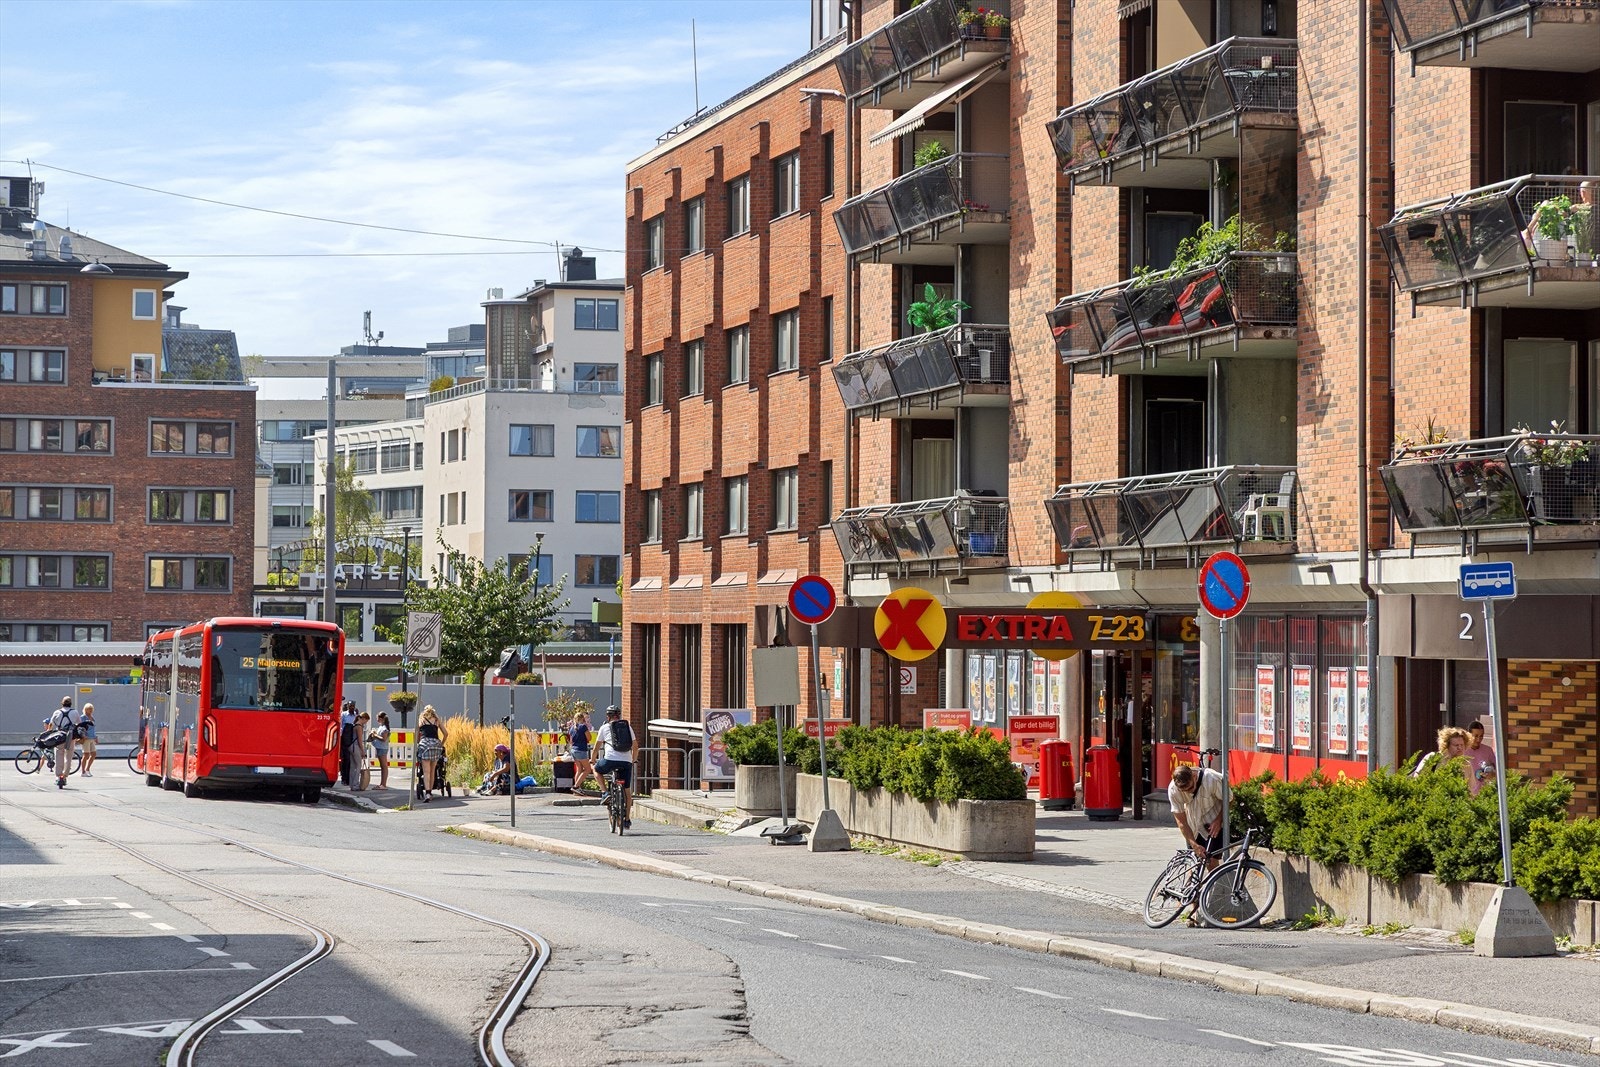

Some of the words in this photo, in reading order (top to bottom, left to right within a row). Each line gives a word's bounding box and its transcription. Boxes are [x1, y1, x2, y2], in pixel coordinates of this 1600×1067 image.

[335, 536, 412, 558] ESTAURAN
[314, 564, 421, 581] LARSEN
[413, 613, 434, 623] Son
[878, 598, 936, 650] X
[957, 614, 1074, 642] EXTRA
[1087, 615, 1145, 642] 7-23
[1459, 612, 1473, 640] 2
[242, 657, 254, 668] 25
[257, 658, 300, 668] Majorstuen
[708, 718, 732, 734] KUPP!
[808, 724, 820, 733] Gjø
[1014, 721, 1027, 730] Gjør
[1028, 721, 1038, 729] det
